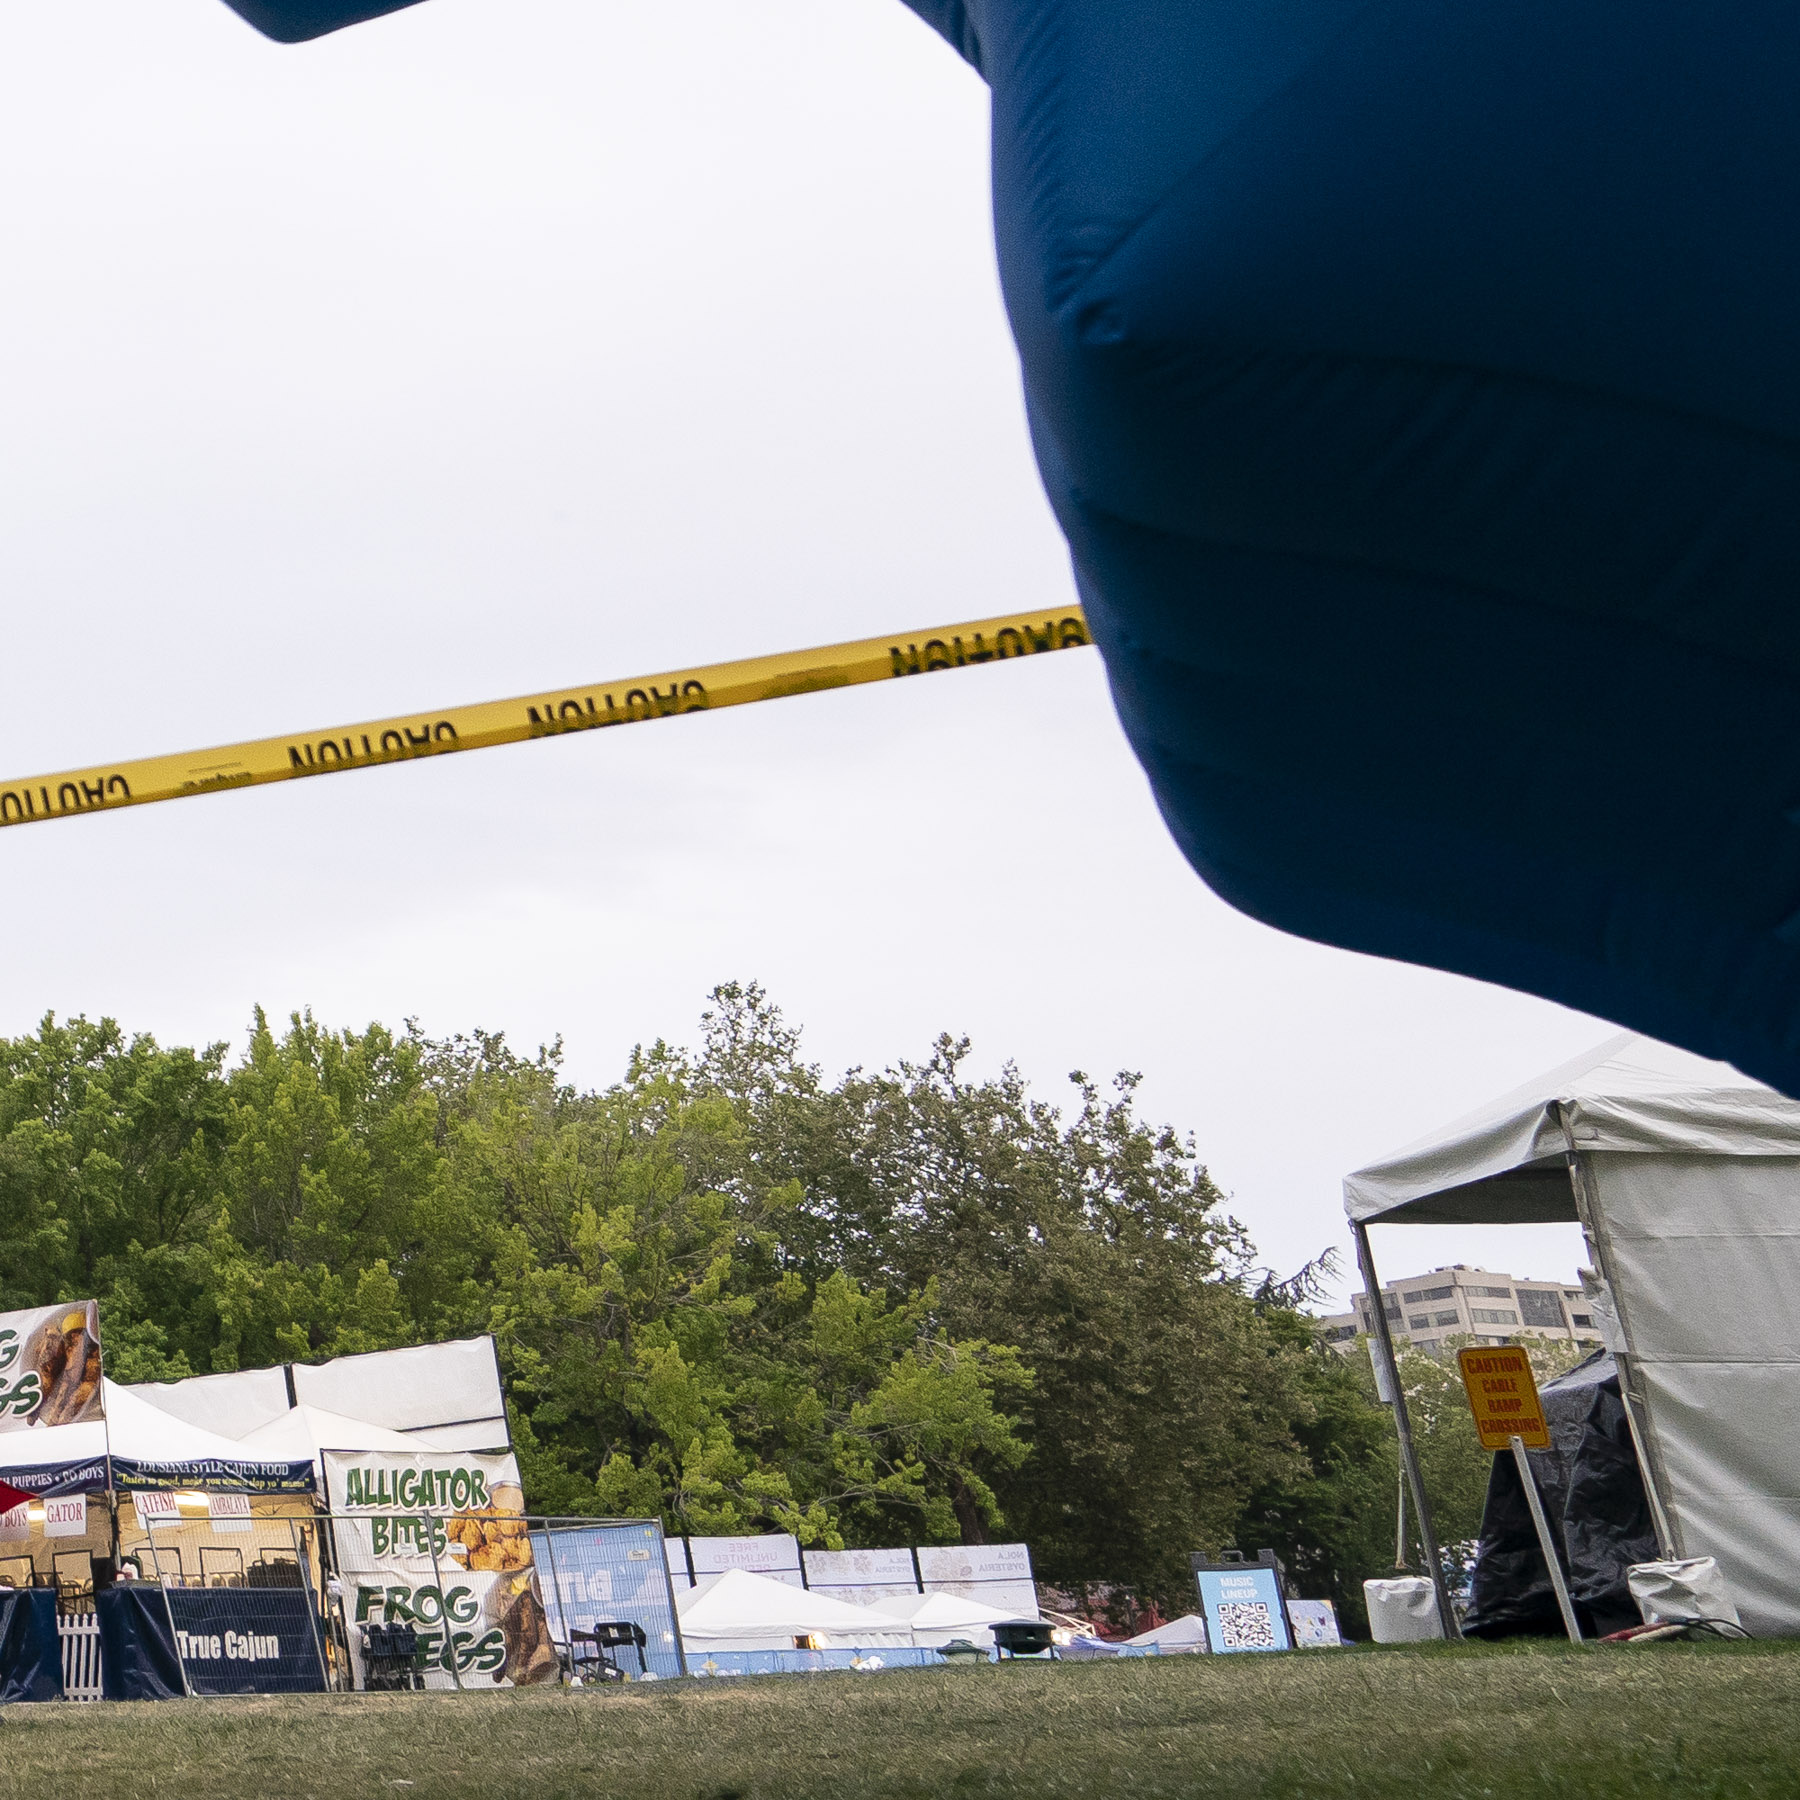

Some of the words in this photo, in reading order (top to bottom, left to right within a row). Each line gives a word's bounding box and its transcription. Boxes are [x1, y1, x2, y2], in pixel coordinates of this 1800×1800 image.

[1466, 1357, 1523, 1374] CAUTION
[1487, 1399, 1523, 1413] RAMP
[1481, 1418, 1541, 1434] CROSSING
[13, 1473, 52, 1488] PUPPIES
[79, 1466, 104, 1480] BOYS
[224, 1462, 259, 1475] CAJUN
[261, 1464, 289, 1475] FOOD
[345, 1467, 491, 1510] ALLIGATOR
[135, 1491, 176, 1514] CATFISH
[5, 1507, 27, 1528] BOYS
[47, 1503, 83, 1523] GATOR
[372, 1517, 447, 1556] BITES
[1220, 1576, 1254, 1587] MUSIC
[1221, 1588, 1258, 1600] LINEUP
[355, 1585, 479, 1625] FROG
[176, 1630, 221, 1659] True
[224, 1630, 279, 1662] Cajun
